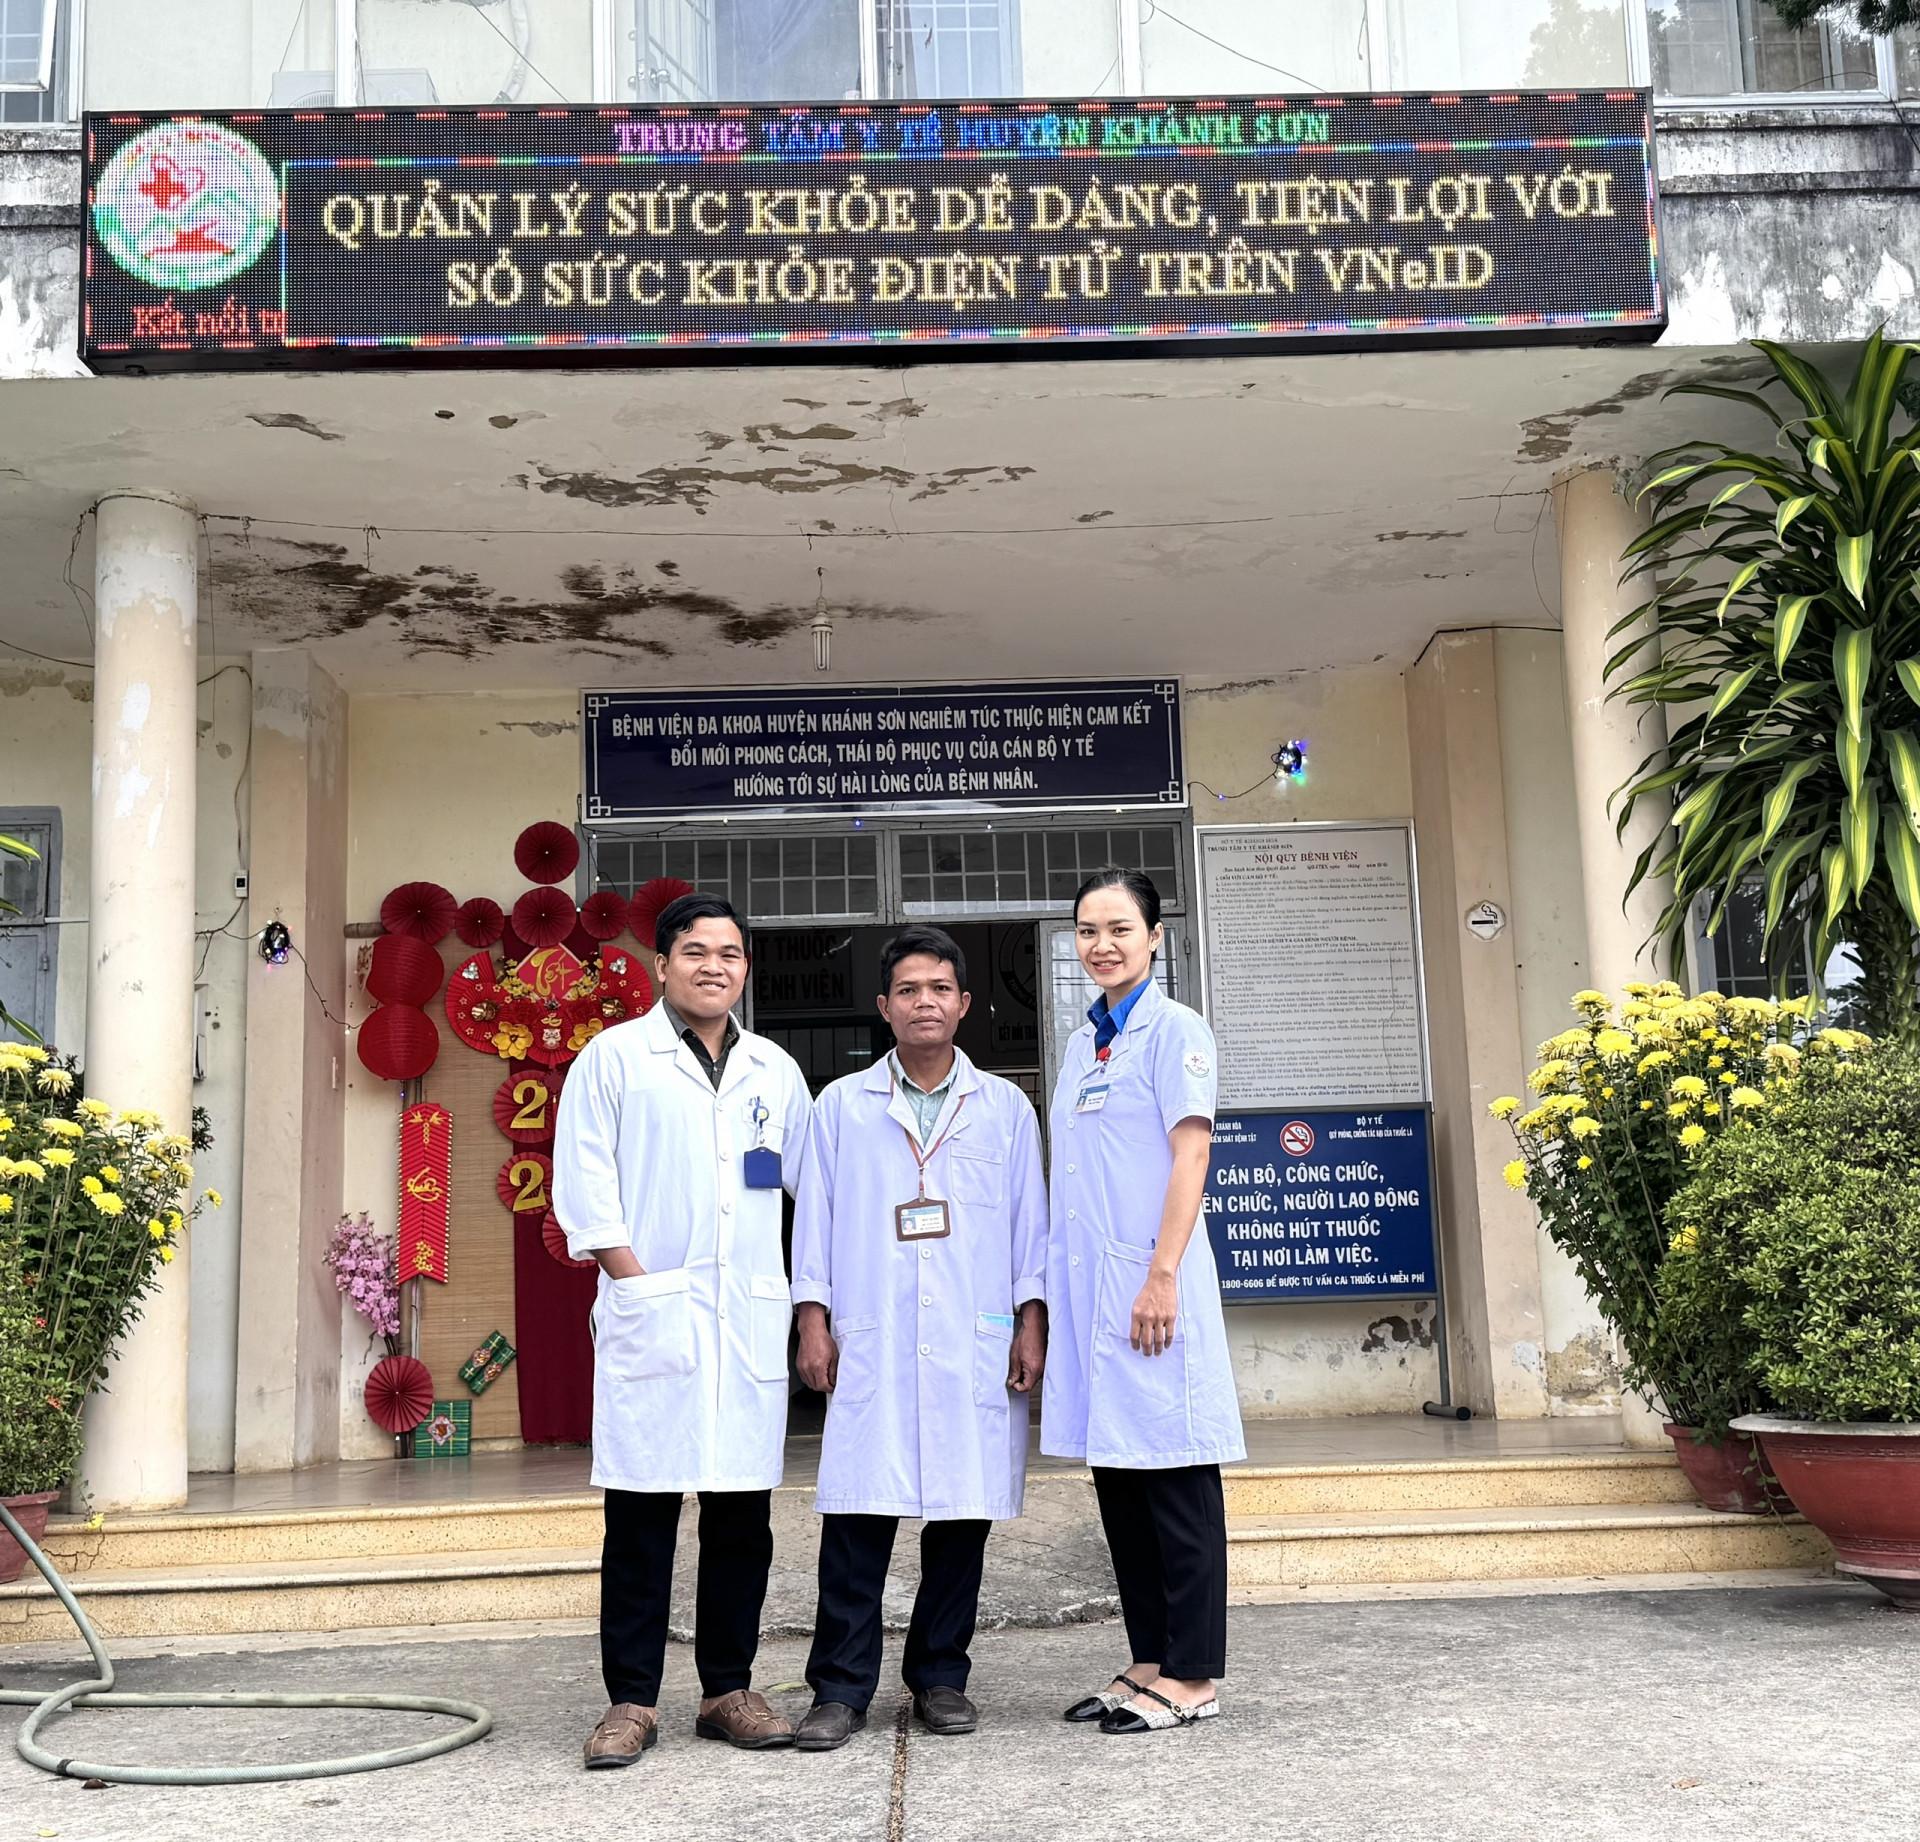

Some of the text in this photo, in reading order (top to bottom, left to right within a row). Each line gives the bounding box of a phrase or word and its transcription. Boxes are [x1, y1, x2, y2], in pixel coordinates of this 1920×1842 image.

[615, 104, 1330, 152] TRUNG TÂM Y TẾ HUYỆN KHÁNH SƠN
[323, 163, 1616, 250] QUẢN LÝ SỨC KHỎE DỄ DÀNG, TIỆN LỢI VỚI
[448, 236, 1494, 311] SỔ SỨC KHỎE ĐIỆN TỬ TRÊN VNeID
[612, 699, 1151, 740] BỆNH VIỆN ĐA KHOA HUYỆN KHÁNH SƠN NGHIÊM TÚC THỰC HIỆN CAM KẾT
[671, 732, 1095, 767] ĐỔI MỚI PHONG CÁCH, THÁI ĐỘ PHỤC VỤ CỦA CÁN BỘ Y TẾ
[734, 766, 1039, 799] HƯỚNG TỚI SỰ HÀI LÒNG CỦA BỆNH NHÂN.
[1254, 850, 1358, 864] NỘI QUY BỆNH VIỆN
[510, 1079, 548, 1129] 2
[1356, 1114, 1384, 1127] BỘ Y TẾ
[509, 1160, 547, 1212] 2
[1216, 1160, 1384, 1188] CÁN BỘ, CÔNG CHỨC,
[1227, 1190, 1278, 1214] CHỨC,
[1283, 1188, 1334, 1211] NGƯỜI
[1338, 1191, 1370, 1209] LAO
[1374, 1187, 1420, 1212] ĐỘNG
[1227, 1213, 1381, 1240] KHÔNG HÚT THUỐC
[1231, 1242, 1379, 1271] TẠI NƠI LÀM VIỆC.
[1222, 1270, 1425, 1289] 1800-6606 ĐỂ ĐƯỢC TƯ VẤN CAI THUỐC LÁ MIỄN PHÍ
